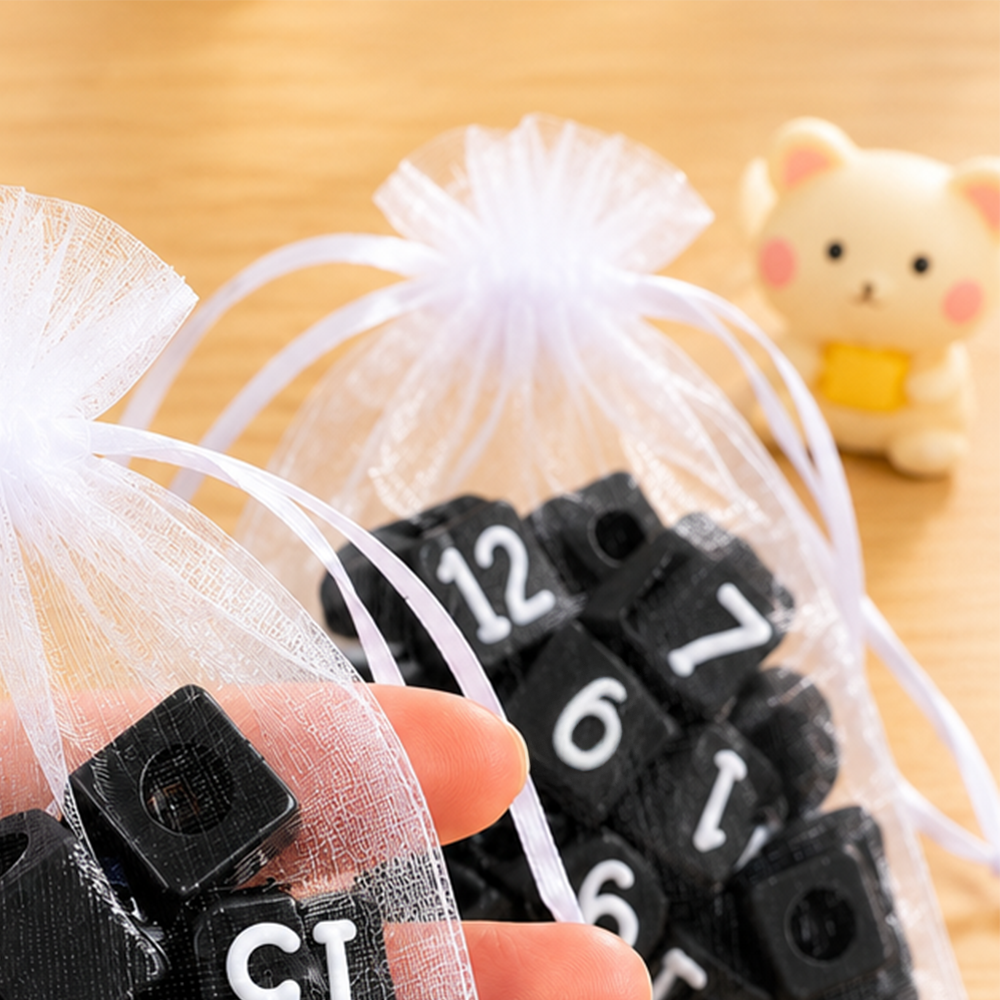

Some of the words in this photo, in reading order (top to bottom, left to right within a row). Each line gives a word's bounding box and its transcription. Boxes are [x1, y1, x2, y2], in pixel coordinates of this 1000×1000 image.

[437, 525, 557, 644] 12
[668, 583, 774, 678] 7
[553, 677, 628, 771] 6
